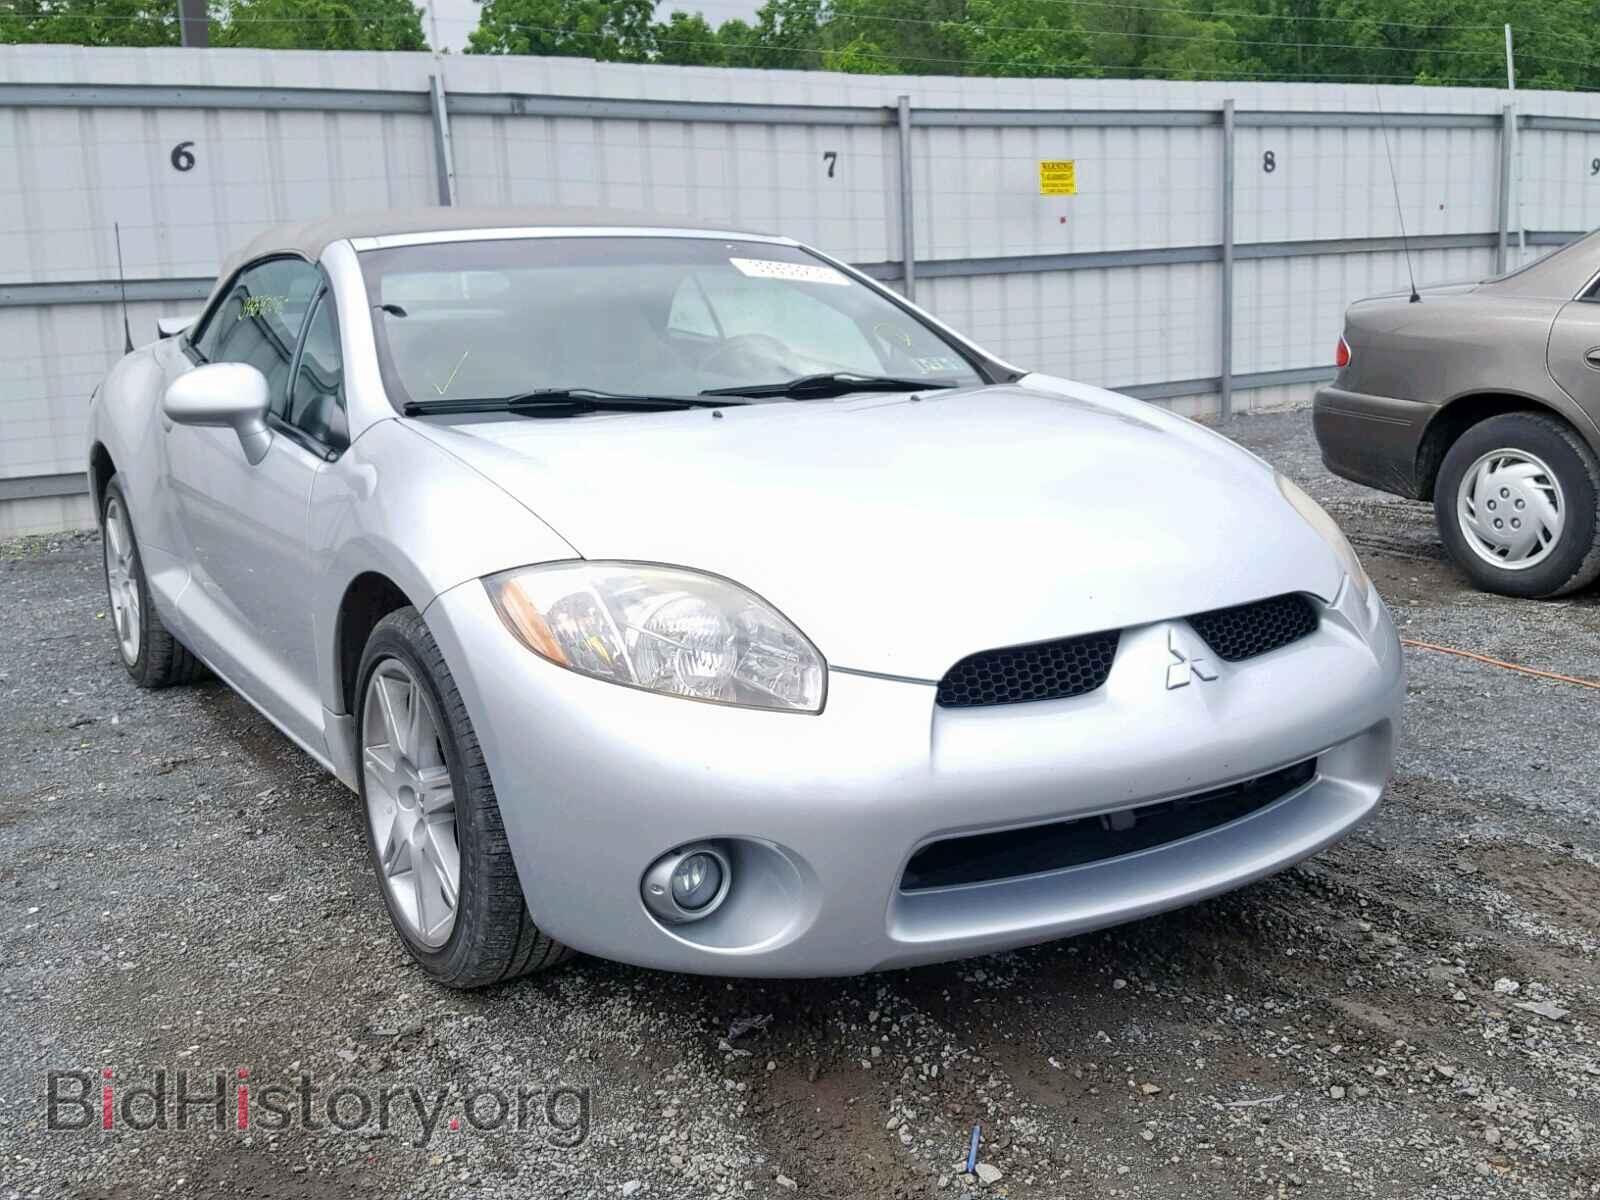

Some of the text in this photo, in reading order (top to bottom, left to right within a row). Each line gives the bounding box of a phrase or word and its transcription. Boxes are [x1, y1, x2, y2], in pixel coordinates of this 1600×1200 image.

[171, 141, 195, 171] 6
[824, 151, 837, 178] 7
[1264, 151, 1275, 173] 8
[1590, 158, 1600, 176] 9
